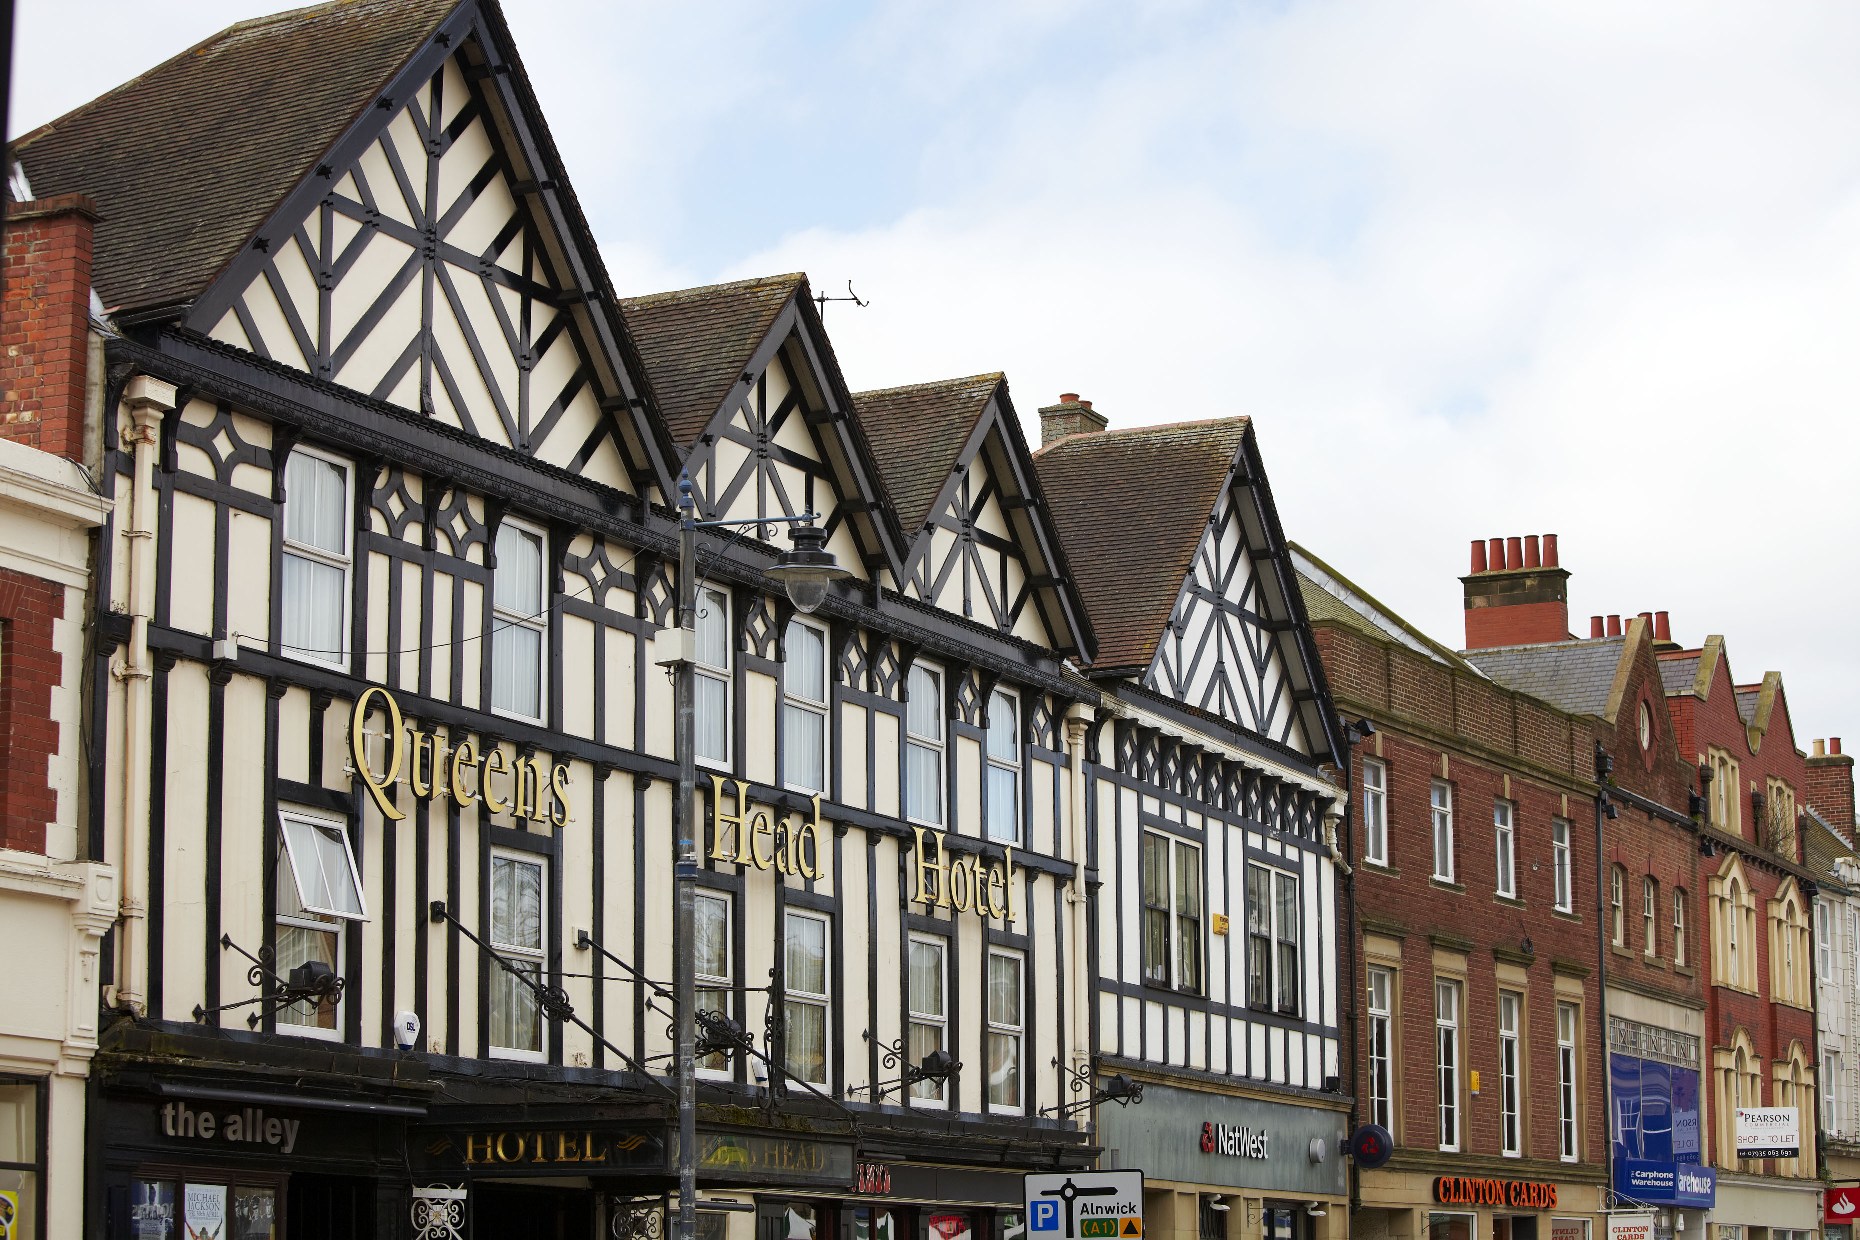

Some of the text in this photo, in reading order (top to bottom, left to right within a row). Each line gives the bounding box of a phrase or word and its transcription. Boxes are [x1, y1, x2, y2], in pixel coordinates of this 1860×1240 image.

[350, 687, 1016, 922] Queens Head Hotel
[1744, 1113, 1790, 1123] PEARSON
[160, 1102, 300, 1153] the alley
[1217, 1123, 1269, 1159] NatWest
[1737, 1135, 1759, 1144] SHOP
[1768, 1134, 1779, 1143] TO
[1780, 1134, 1795, 1143] LET
[466, 1131, 607, 1165] HOTEL
[1635, 1170, 1674, 1179] Carphone
[1631, 1178, 1674, 1187] Warehouse
[187, 1192, 220, 1203] MICHAEL
[1435, 1176, 1558, 1208] CLINTON CARDS
[187, 1201, 221, 1211] JACKSON
[1080, 1201, 1137, 1216] Alnwick
[1037, 1203, 1054, 1228] P
[1082, 1219, 1116, 1236] (A1)
[1612, 1225, 1649, 1234] CLINTON
